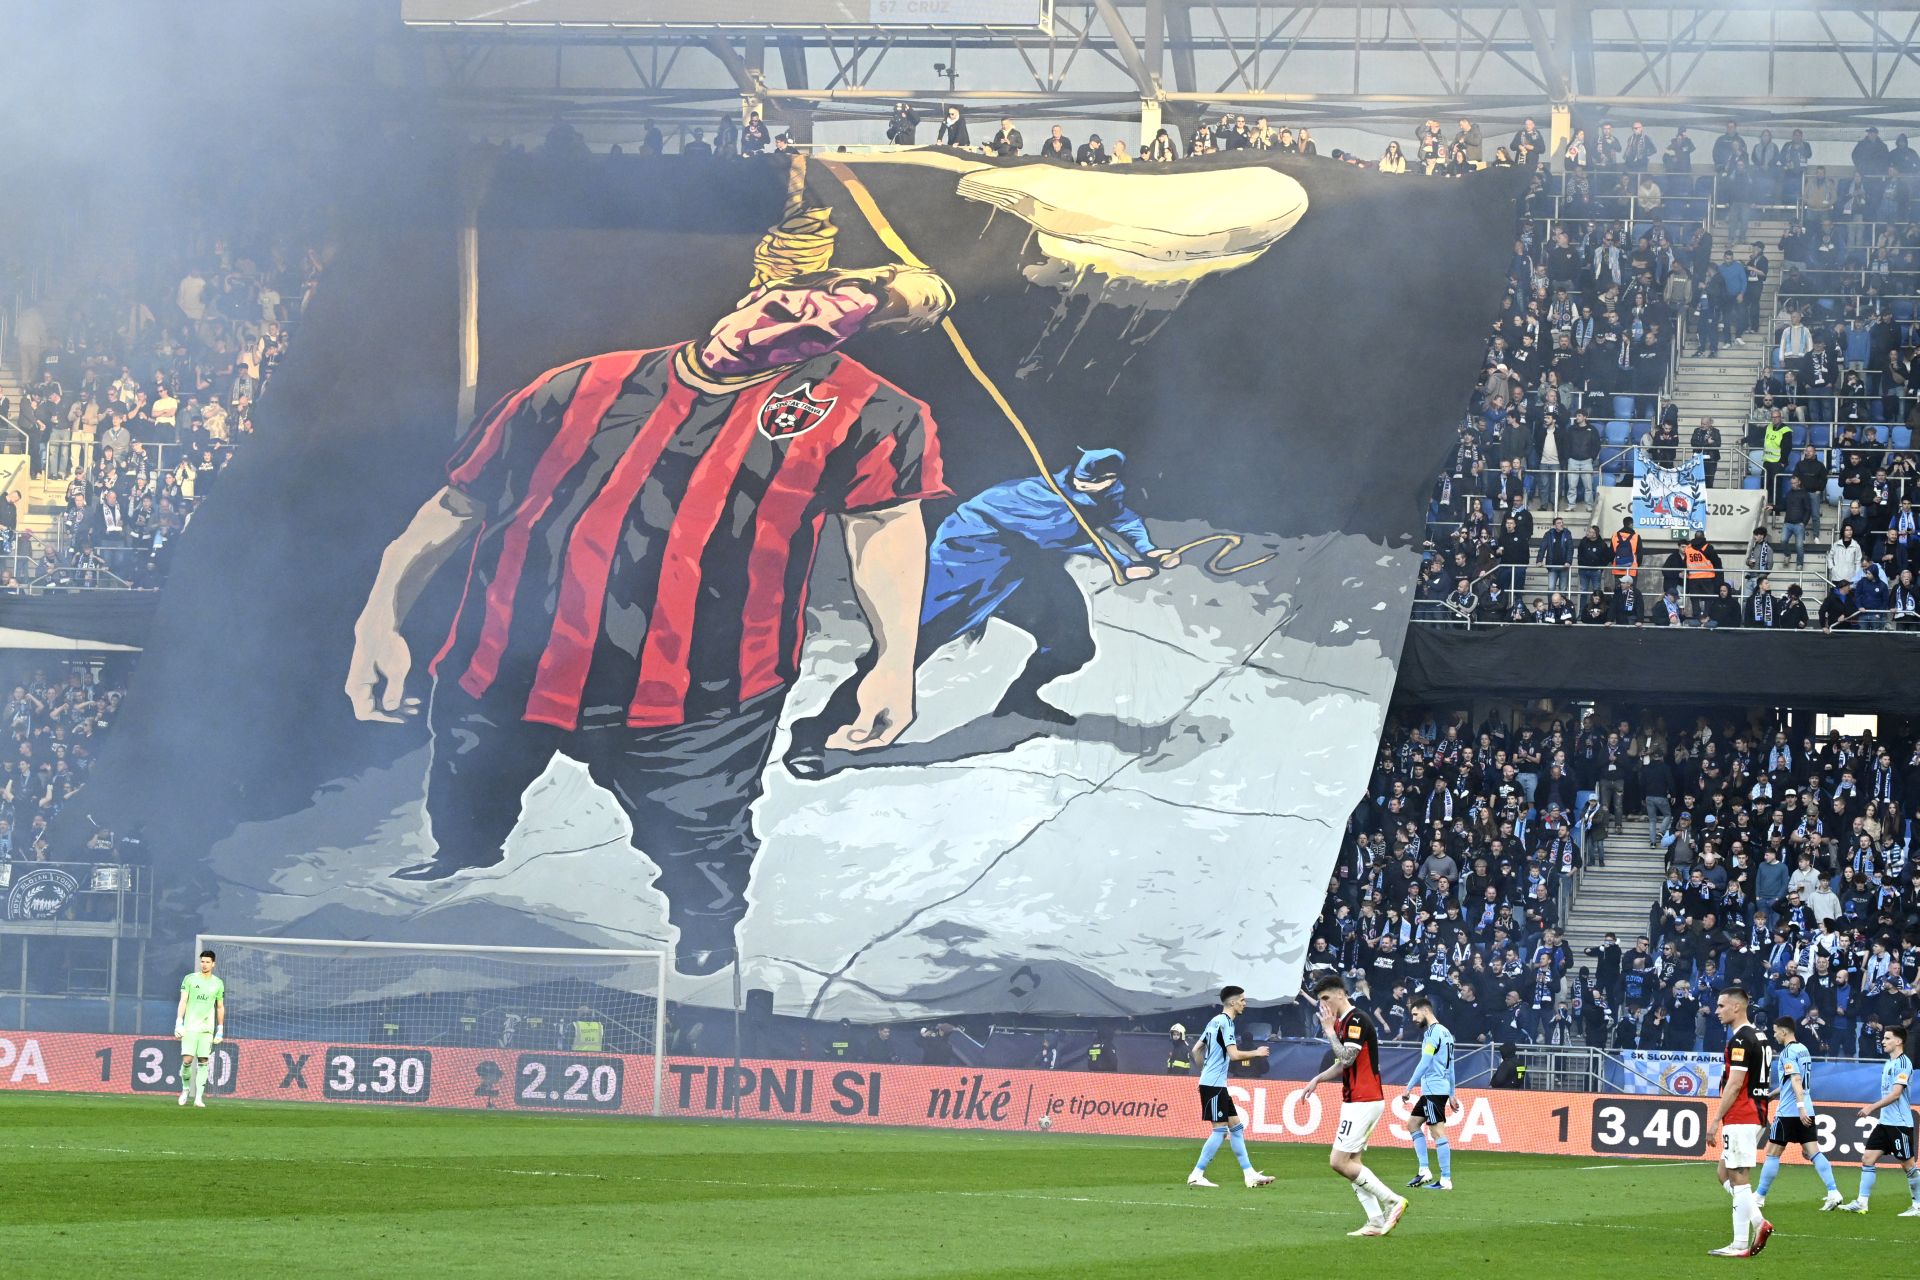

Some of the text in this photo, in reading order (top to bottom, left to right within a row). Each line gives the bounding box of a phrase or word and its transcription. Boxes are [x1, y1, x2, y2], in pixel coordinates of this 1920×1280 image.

[95, 1047, 112, 1082] 1
[138, 1047, 231, 1086] 3.0
[279, 1053, 311, 1089] X
[329, 1054, 425, 1094] 3.30
[521, 1062, 617, 1102] 2.20
[1631, 1052, 1644, 1060] ŠK
[1647, 1053, 1688, 1062] SLOVAN
[669, 1064, 881, 1117] TIPNI SI
[927, 1074, 1169, 1122] niké je tipovanie
[1339, 1119, 1352, 1136] 91
[1551, 1106, 1570, 1143] 1
[1598, 1106, 1701, 1148] 3.40
[1894, 1138, 1901, 1151] 8
